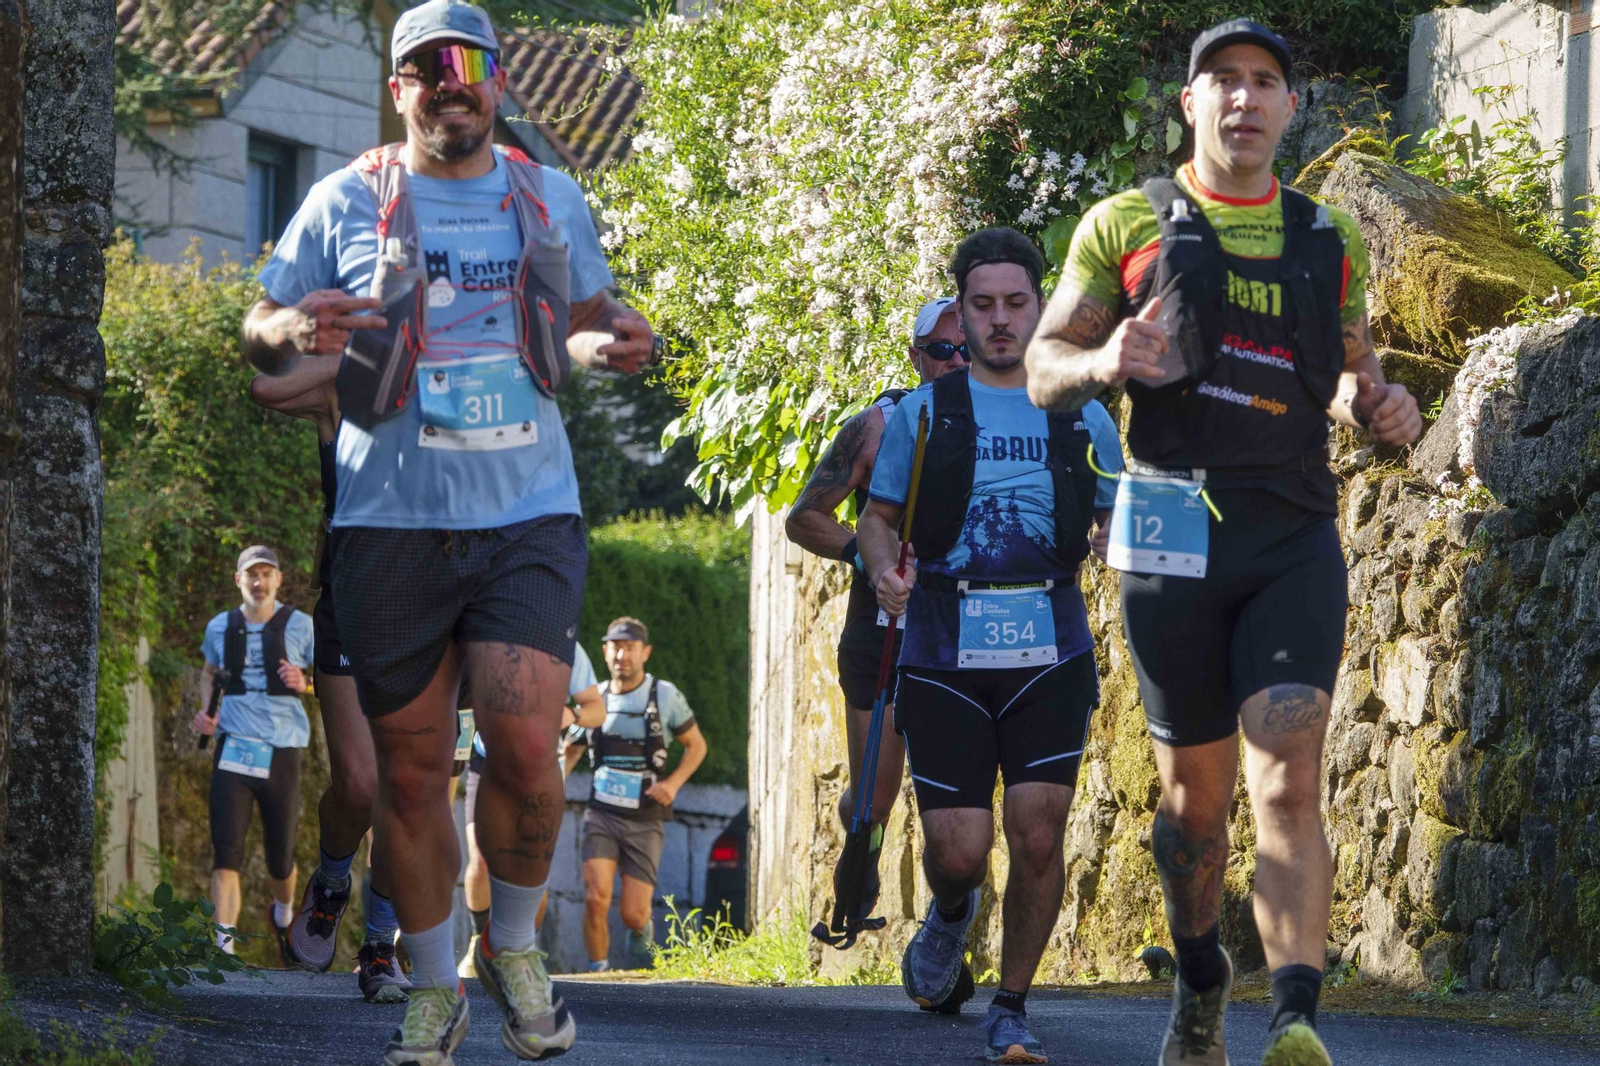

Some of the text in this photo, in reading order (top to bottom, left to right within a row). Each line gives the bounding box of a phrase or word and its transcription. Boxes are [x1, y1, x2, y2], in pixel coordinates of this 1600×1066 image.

[458, 248, 487, 261] Trail
[461, 258, 518, 278] Entre
[464, 393, 503, 424] 311
[1133, 515, 1163, 544] 12
[984, 620, 1036, 645] 354
